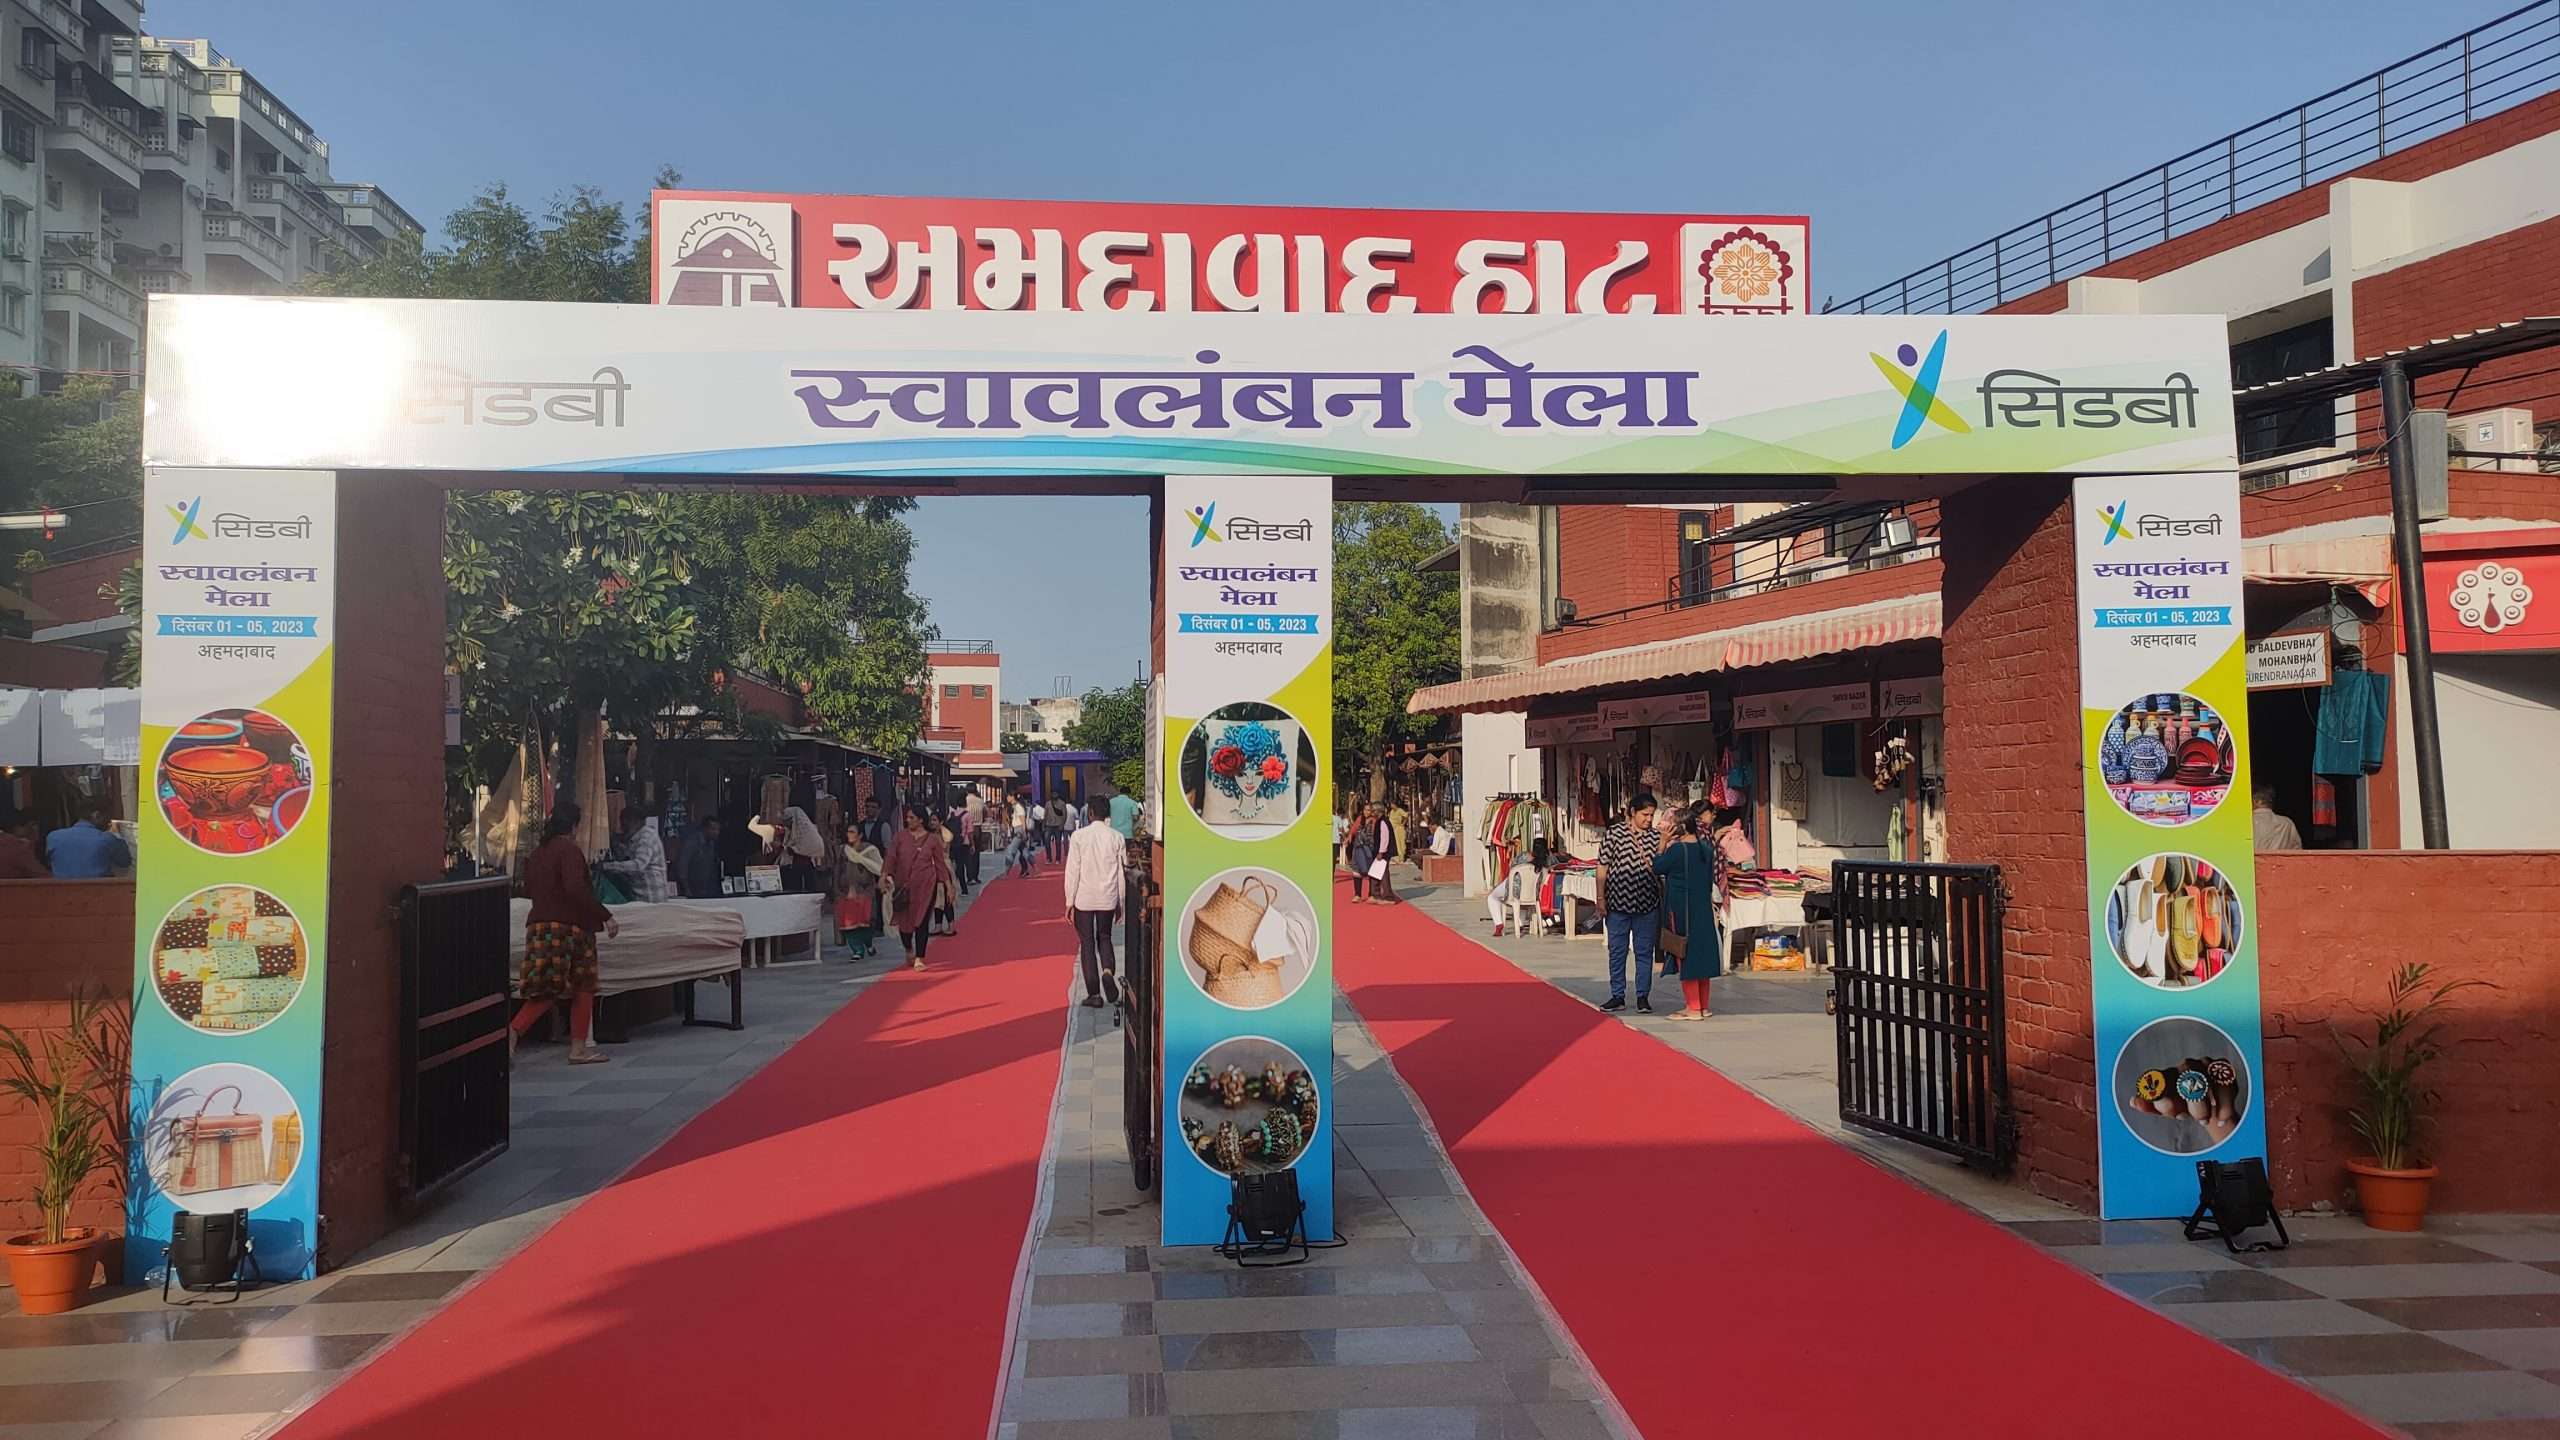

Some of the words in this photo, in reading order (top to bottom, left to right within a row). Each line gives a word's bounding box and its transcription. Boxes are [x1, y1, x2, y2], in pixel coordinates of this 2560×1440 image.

[827, 222, 1417, 314] અમદાવાદ
[1451, 239, 1658, 315] હાટ
[790, 349, 1415, 429] स्वावलंबन
[1449, 345, 1700, 429] मेला
[1976, 368, 2199, 429] सिडबी
[211, 513, 313, 540] सिडबी
[1225, 517, 1313, 542] सिडबी
[2136, 514, 2223, 537] सिडबी
[158, 562, 318, 583] स्वावलंबन
[1178, 563, 1319, 582] स्वावलंबन
[2092, 557, 2230, 578] स्वावलंबन
[205, 585, 272, 607] मेला
[1220, 585, 1279, 606] मेला
[2133, 580, 2191, 600] मेला
[171, 617, 214, 634] दिसंबर
[217, 620, 231, 633] 01
[247, 620, 266, 635] 05,
[271, 621, 304, 634] 2023
[1190, 615, 1228, 631] दिसंबर
[1230, 618, 1242, 631] 01
[1257, 618, 1275, 633] 05,
[1279, 618, 1307, 632] 2023
[2106, 609, 2142, 625] दिसंबर
[2145, 612, 2156, 624] 01
[2170, 611, 2189, 625] 05,
[2192, 610, 2220, 624] 2023
[1214, 641, 1283, 657] अहमदाबाद
[2130, 633, 2197, 649] अहमदाबाद
[2258, 638, 2316, 654] BALDEVBHAI
[198, 645, 277, 661] अहमदाबाद
[2258, 653, 2316, 668] MOHANBHAI
